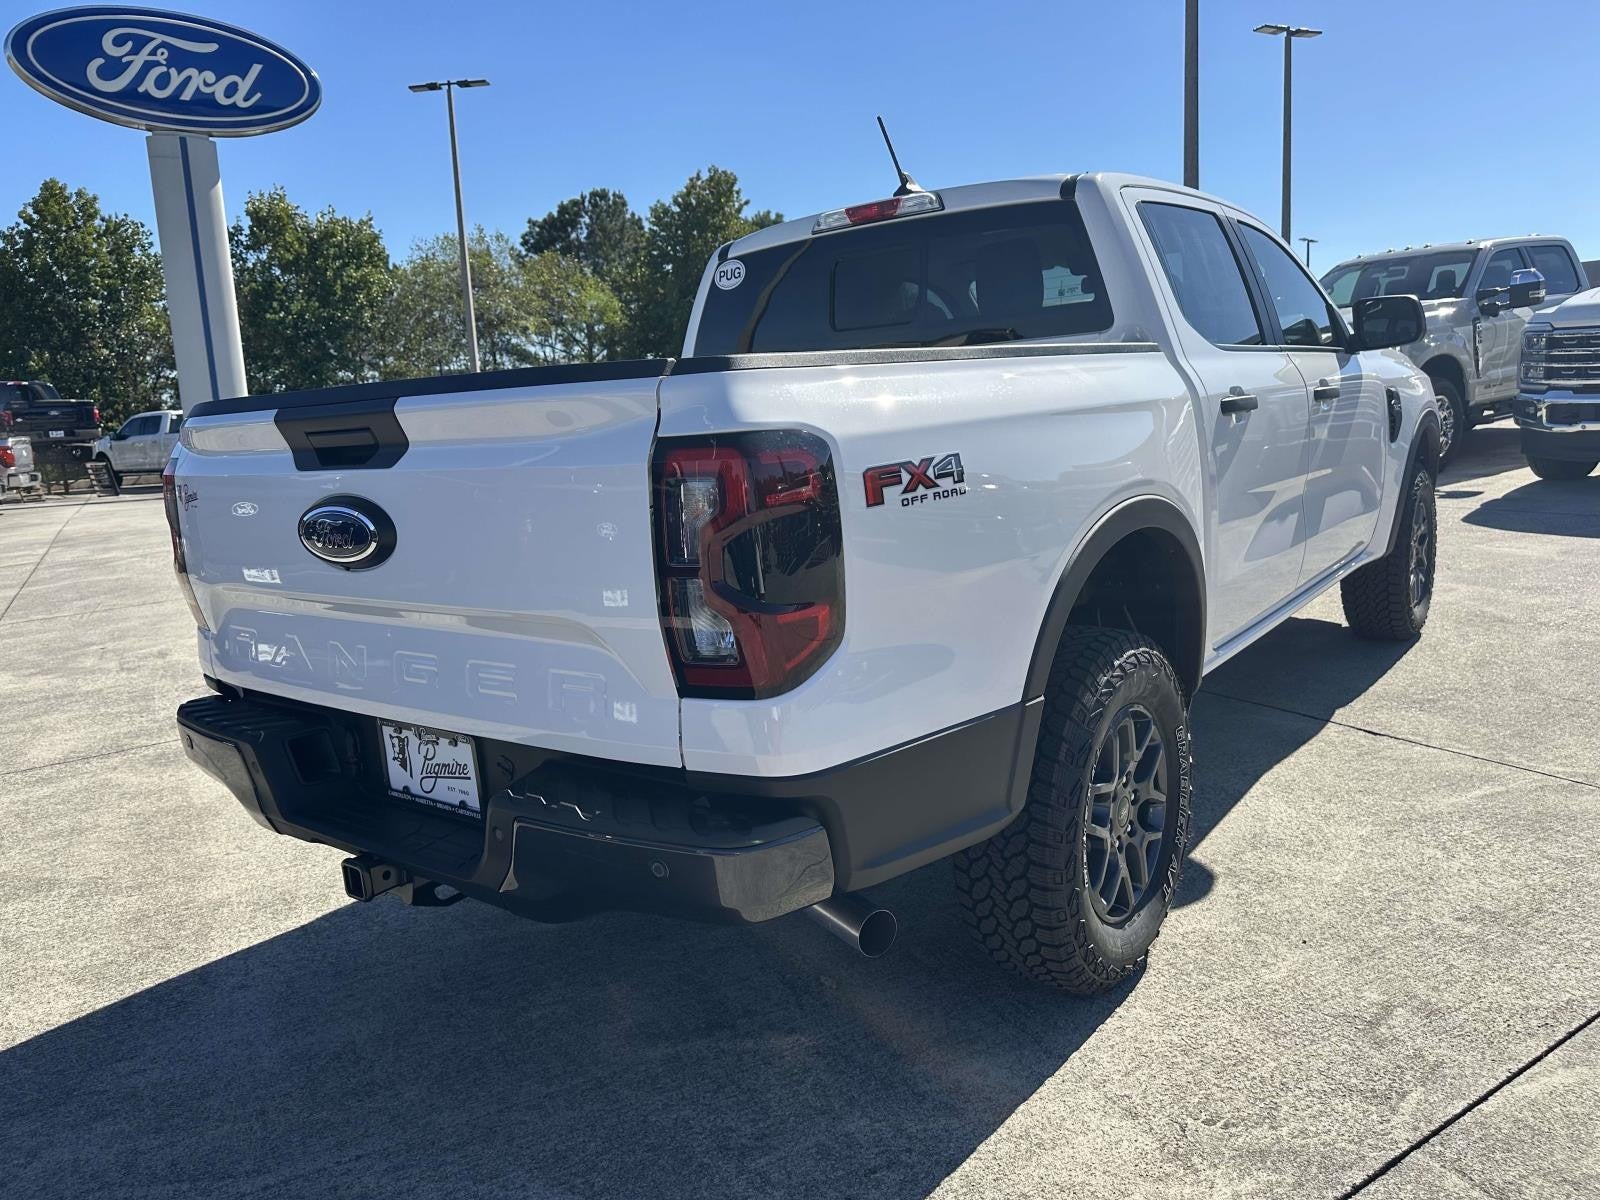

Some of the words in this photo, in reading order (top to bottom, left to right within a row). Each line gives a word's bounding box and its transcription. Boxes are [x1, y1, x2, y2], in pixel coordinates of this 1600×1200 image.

[86, 27, 263, 108] Ford
[718, 266, 741, 282] PUG
[862, 451, 965, 508] FX4
[901, 493, 928, 507] OFF
[933, 486, 967, 501] ROAD
[312, 517, 356, 549] Ford
[226, 624, 609, 714] RANGER
[418, 743, 471, 794] Pugmire
[1174, 724, 1190, 848] GRABBER
[1162, 853, 1178, 902] A/T
